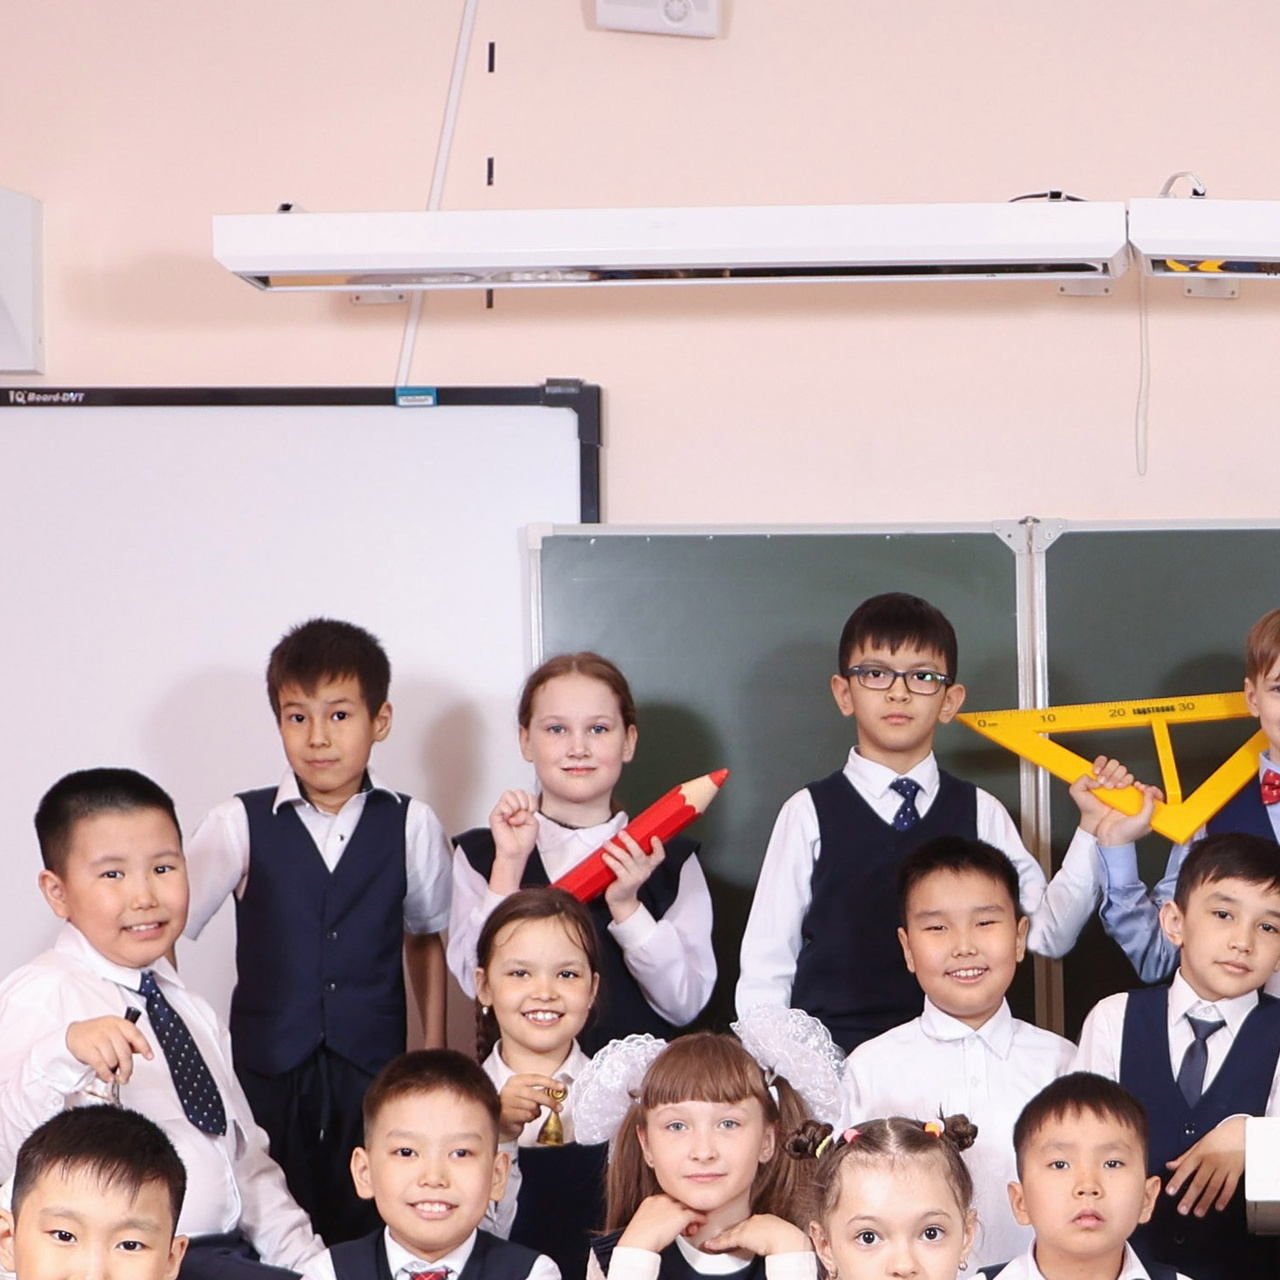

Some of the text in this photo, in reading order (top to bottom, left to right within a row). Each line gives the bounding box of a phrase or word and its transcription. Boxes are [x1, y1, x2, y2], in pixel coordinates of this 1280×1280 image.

[1178, 702, 1195, 711] 30
[1109, 708, 1126, 717] 20
[1040, 713, 1056, 723] 10
[977, 719, 987, 728] 0
